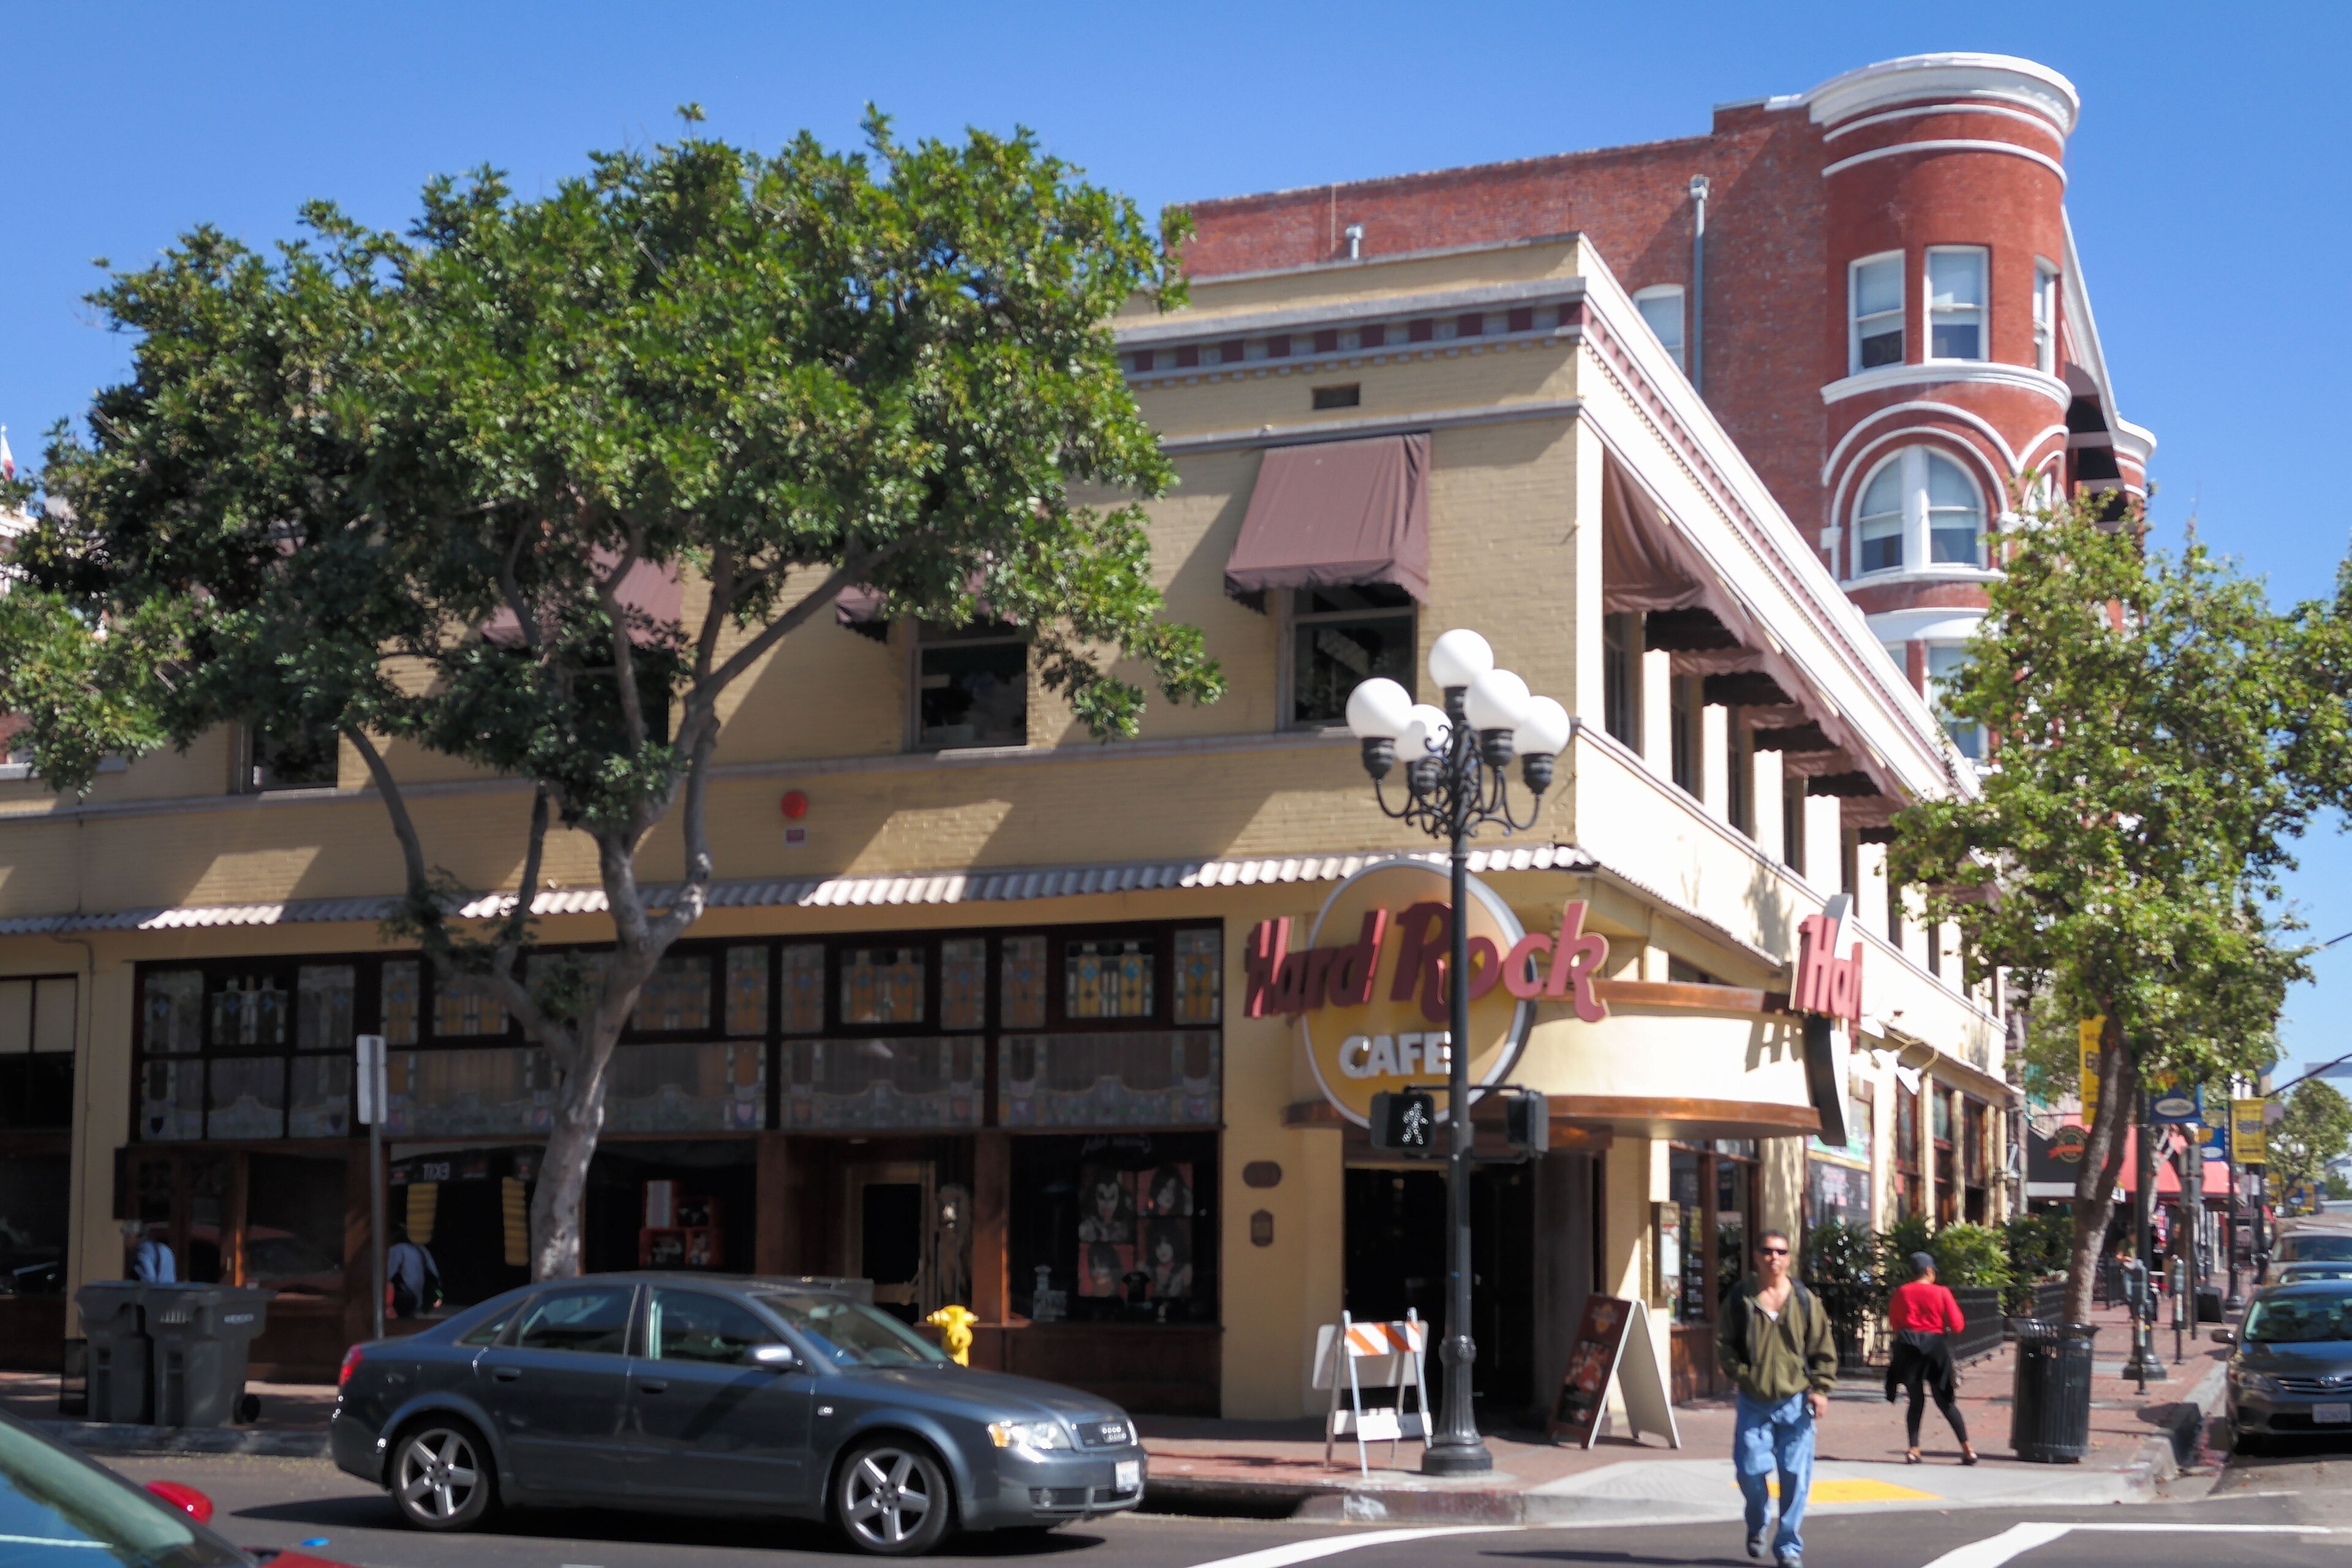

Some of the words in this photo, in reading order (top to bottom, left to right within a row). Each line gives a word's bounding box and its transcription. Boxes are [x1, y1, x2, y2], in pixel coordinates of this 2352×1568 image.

[1243, 908, 1387, 1018] Hard
[1389, 899, 1611, 1023] Rock
[1339, 1030, 1452, 1079] CAFE
